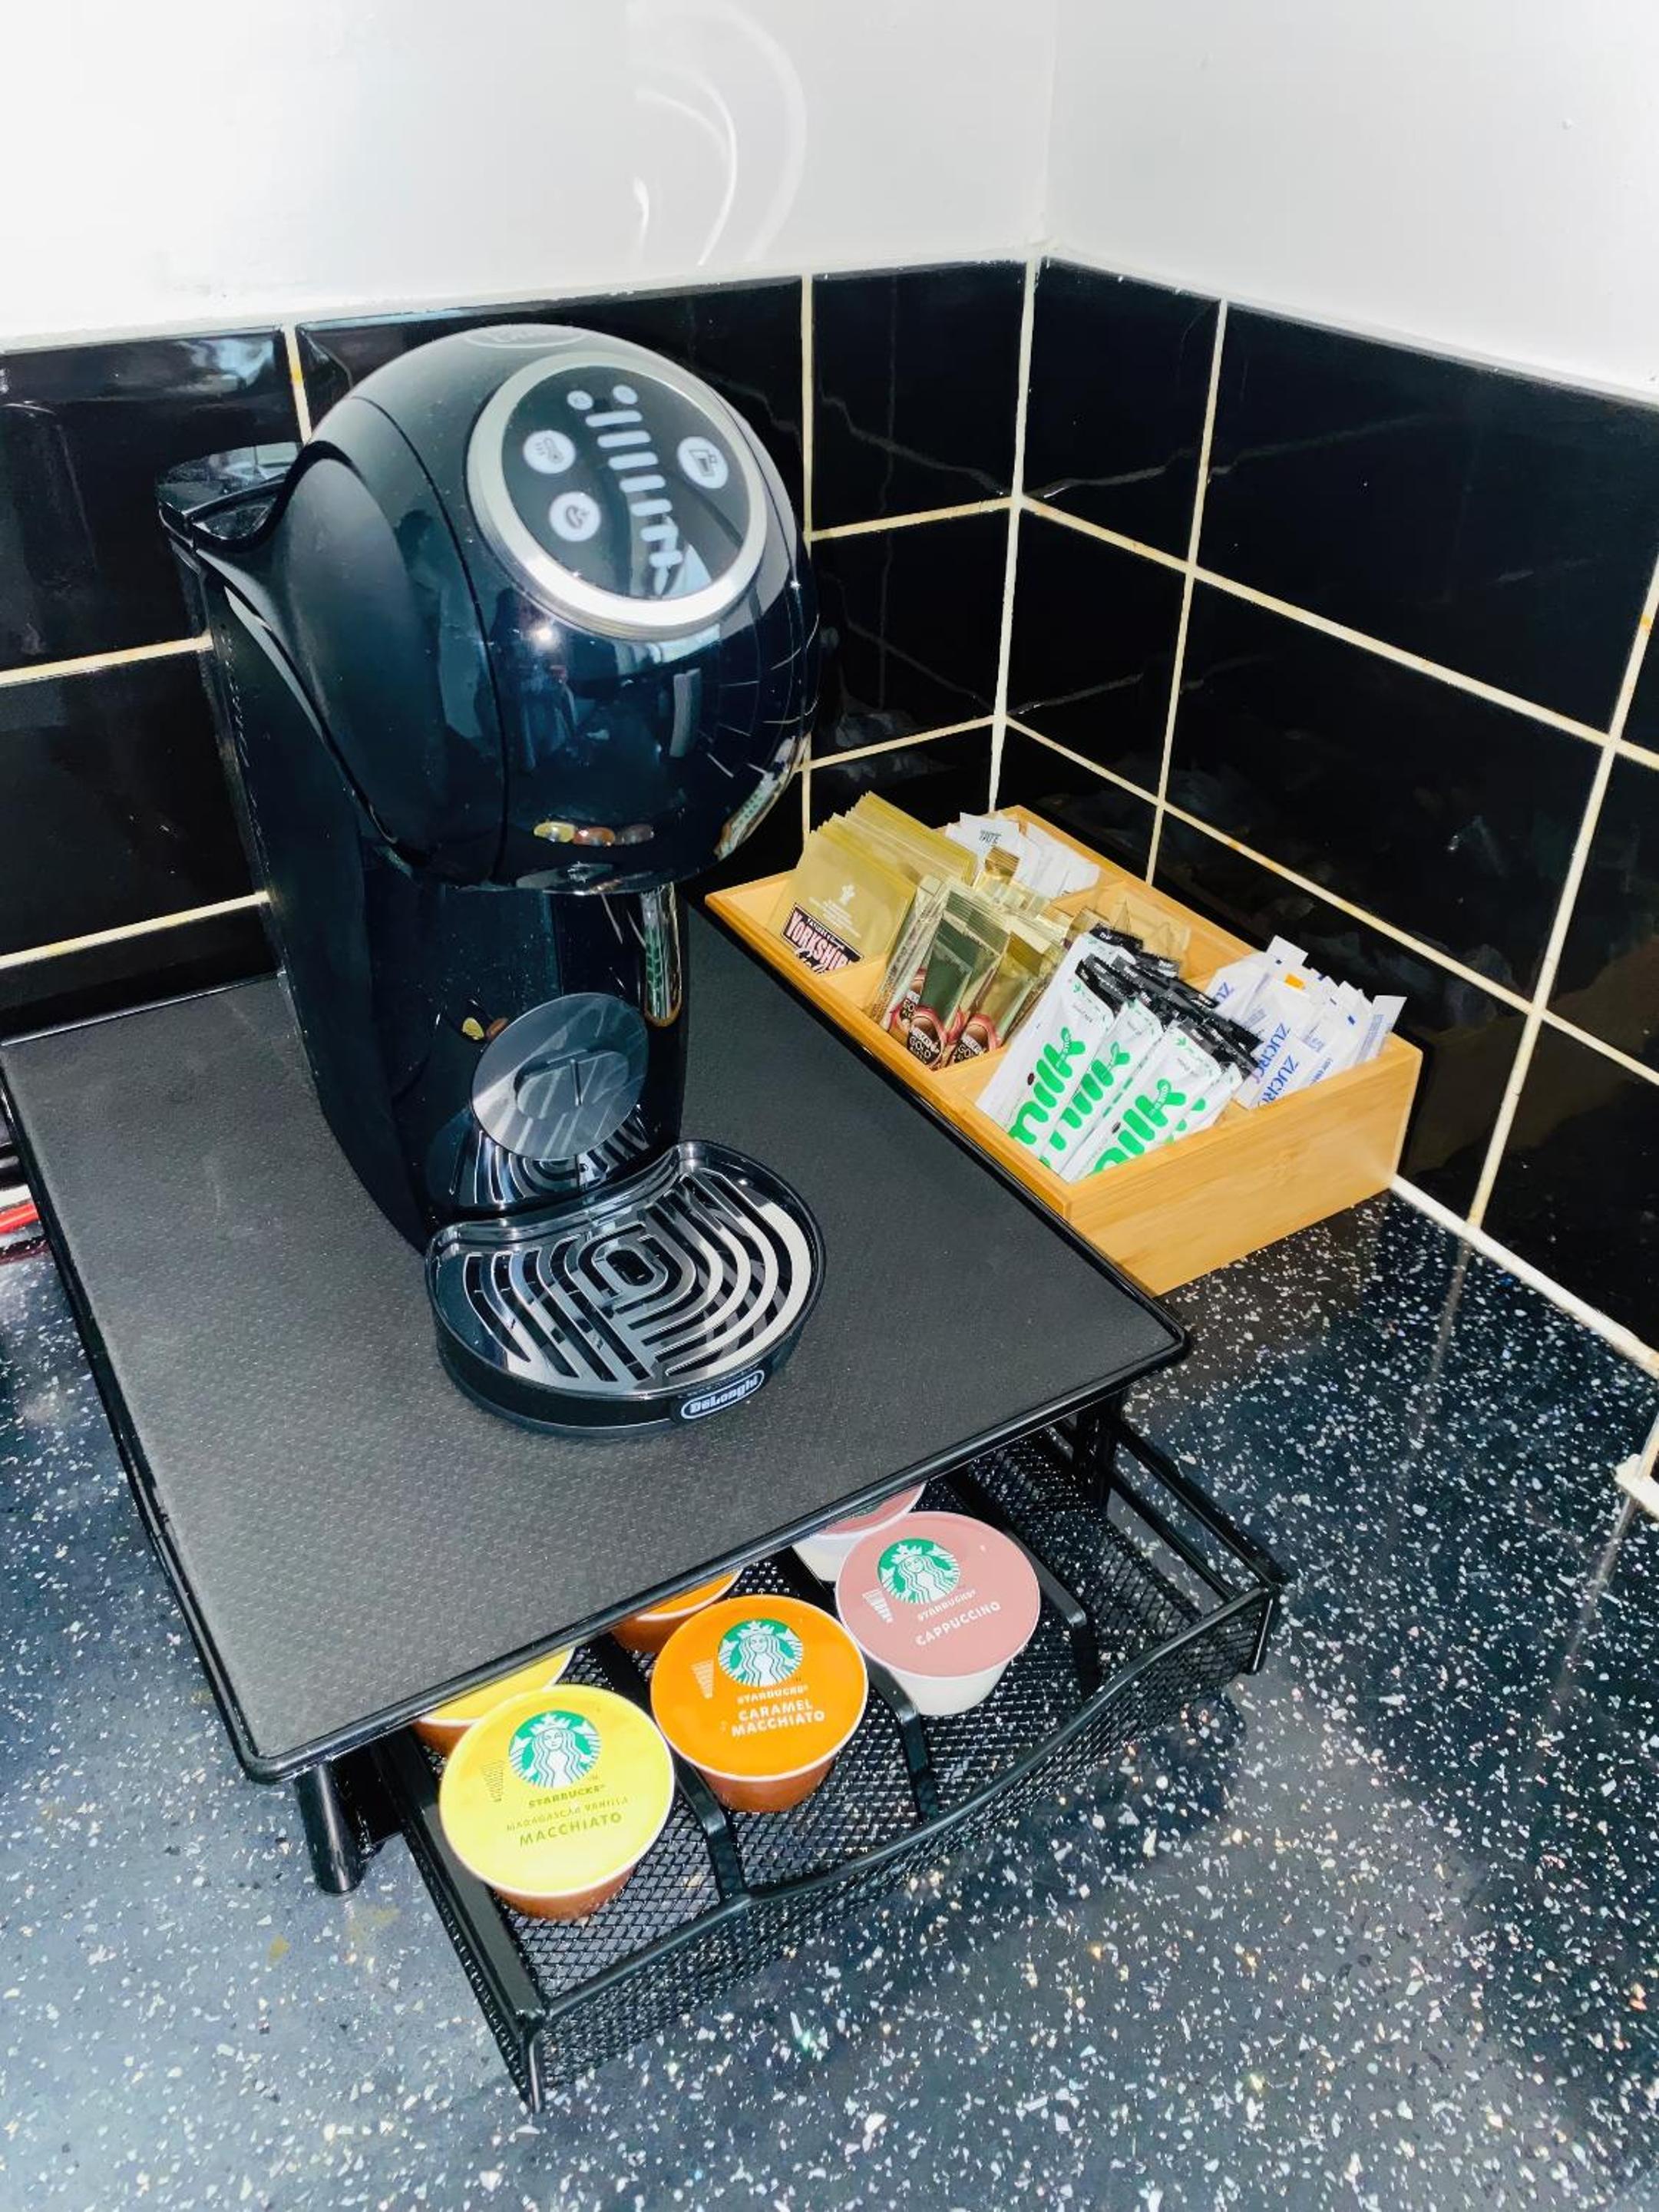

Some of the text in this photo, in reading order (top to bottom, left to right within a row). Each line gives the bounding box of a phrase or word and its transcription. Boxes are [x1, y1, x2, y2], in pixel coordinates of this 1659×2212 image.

[785, 911, 850, 970] YORKSHIR
[915, 1601, 1001, 1645] CAPPUCCINO
[731, 1710, 825, 1738] MACCHIATO
[739, 1698, 812, 1721] CARAMEL
[520, 1812, 623, 1847] MACCHIATO
